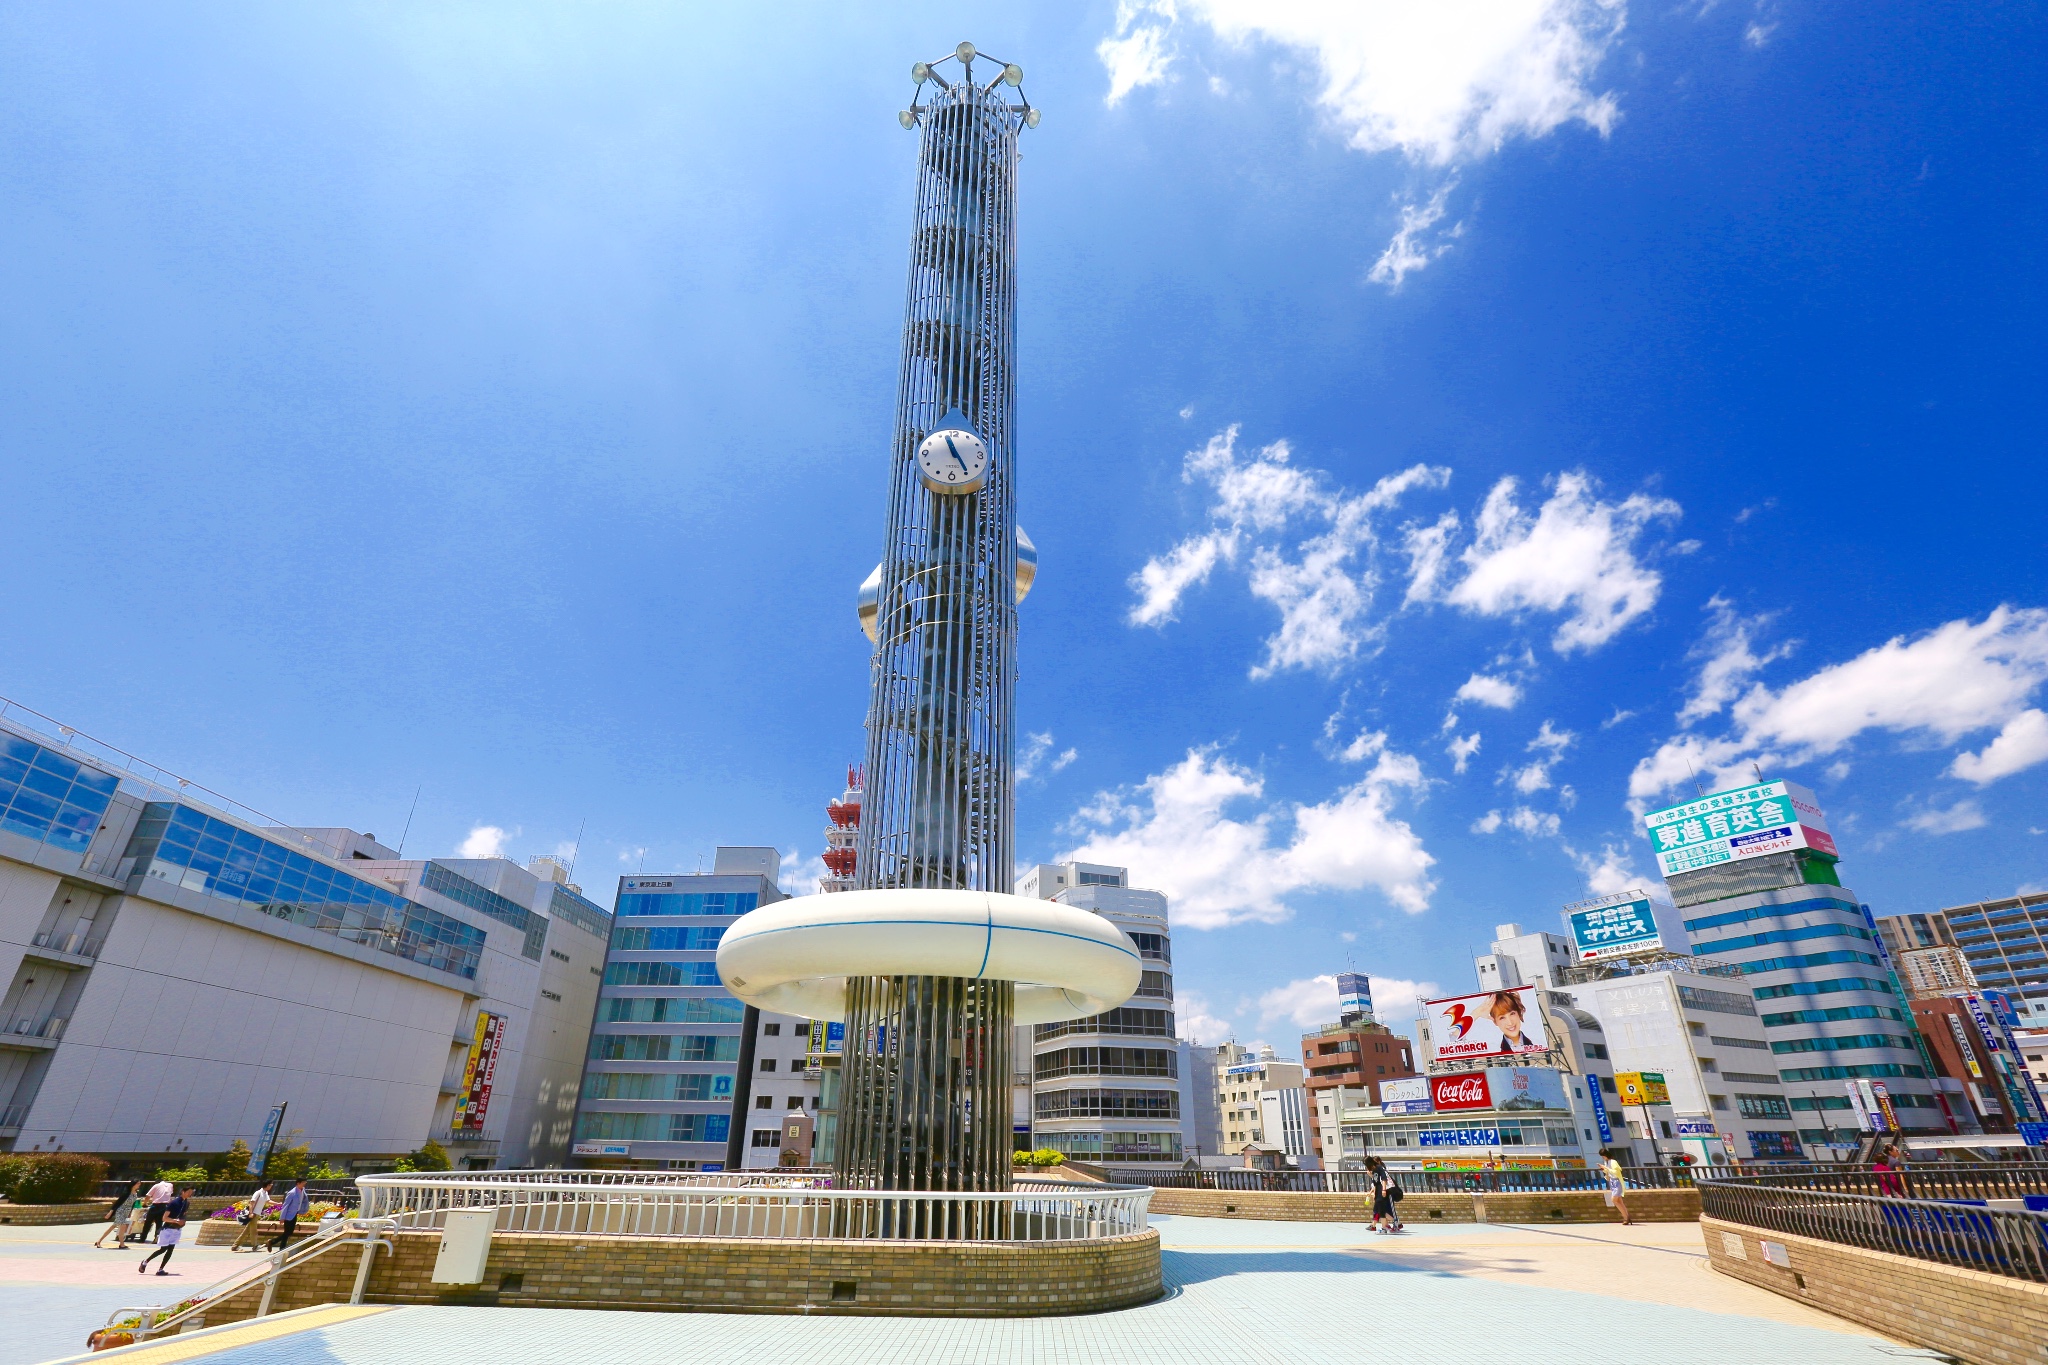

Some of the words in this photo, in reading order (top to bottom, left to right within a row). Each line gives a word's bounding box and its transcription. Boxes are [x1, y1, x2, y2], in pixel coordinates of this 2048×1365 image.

[948, 430, 959, 438] 12
[921, 449, 929, 458] 9
[976, 451, 984, 459] 3
[947, 471, 956, 480] 6
[1655, 786, 1774, 824] 小中高生の受験予備校
[1655, 800, 1786, 851] 東進育英舎
[1583, 919, 1647, 942] マナビス
[472, 1017, 497, 1092] 無印良品
[1439, 1045, 1454, 1055] BIG
[1455, 1041, 1488, 1053] MARCH
[1437, 1078, 1484, 1104] Coca-Cola
